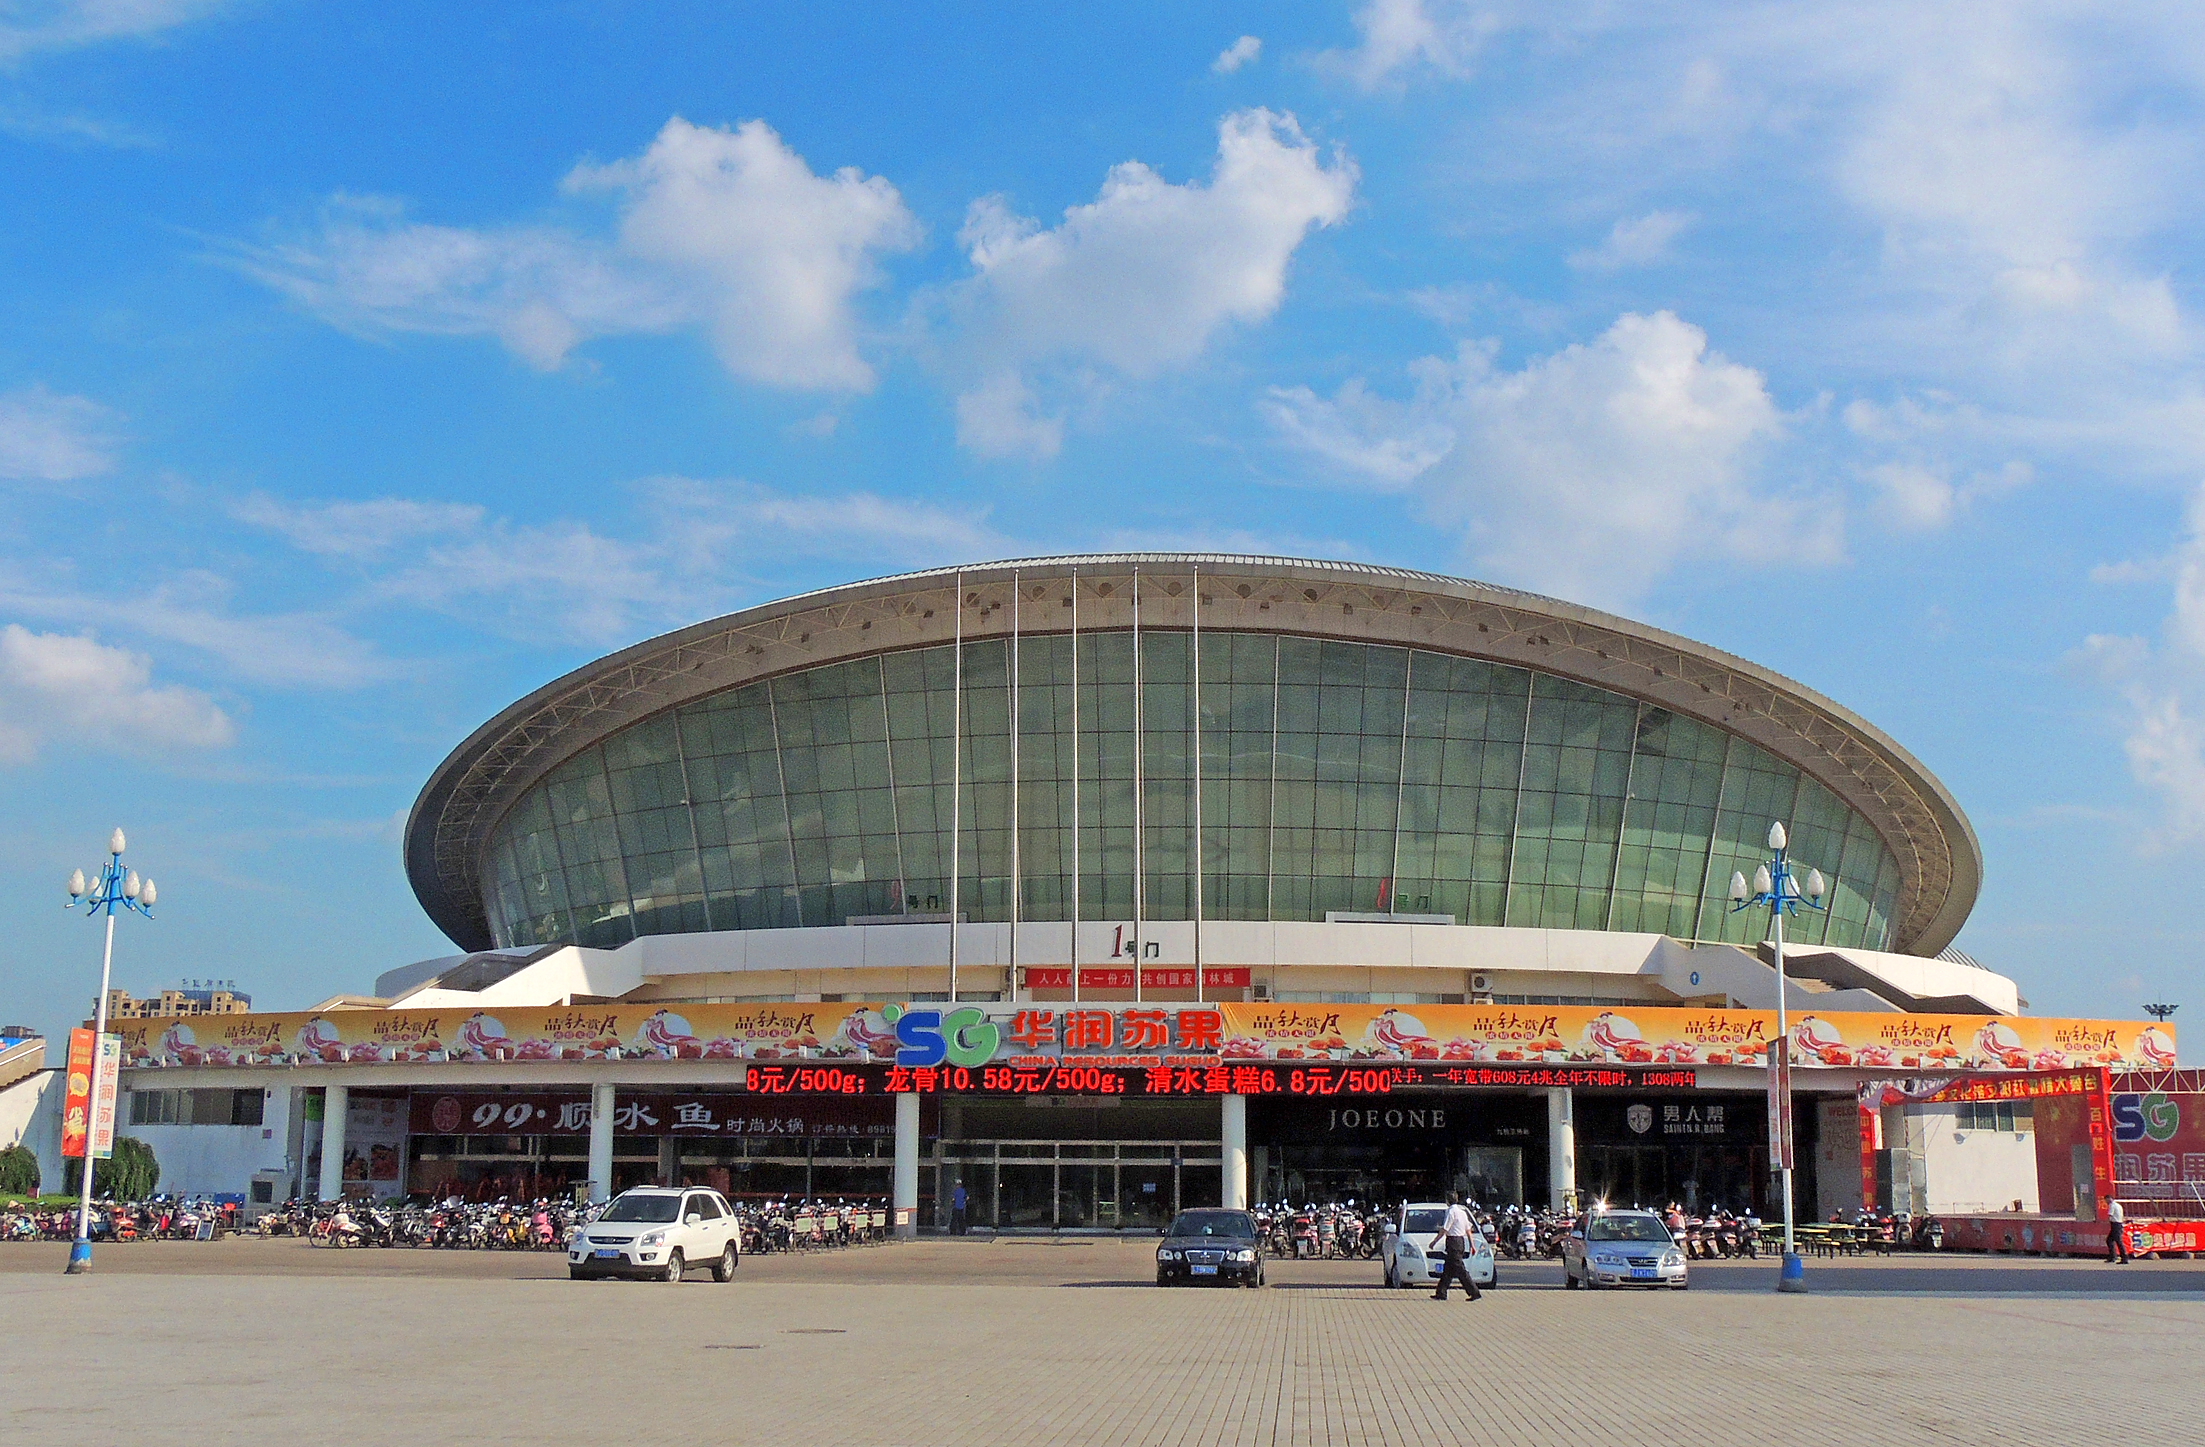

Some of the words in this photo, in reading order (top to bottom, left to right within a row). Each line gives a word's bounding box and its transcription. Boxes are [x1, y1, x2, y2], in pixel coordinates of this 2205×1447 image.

[896, 1007, 999, 1068] SG
[1008, 1008, 1224, 1050] 华润苏果
[1009, 1055, 1057, 1067] CHINA
[1063, 1055, 1160, 1067] RESOURCES
[1165, 1055, 1221, 1067] SUGUO
[98, 1061, 116, 1146] 华润苏果
[1664, 1105, 1724, 1122] 男人帮
[726, 1117, 804, 1133] 时尚火锅
[1329, 1109, 1446, 1131] JOEONE
